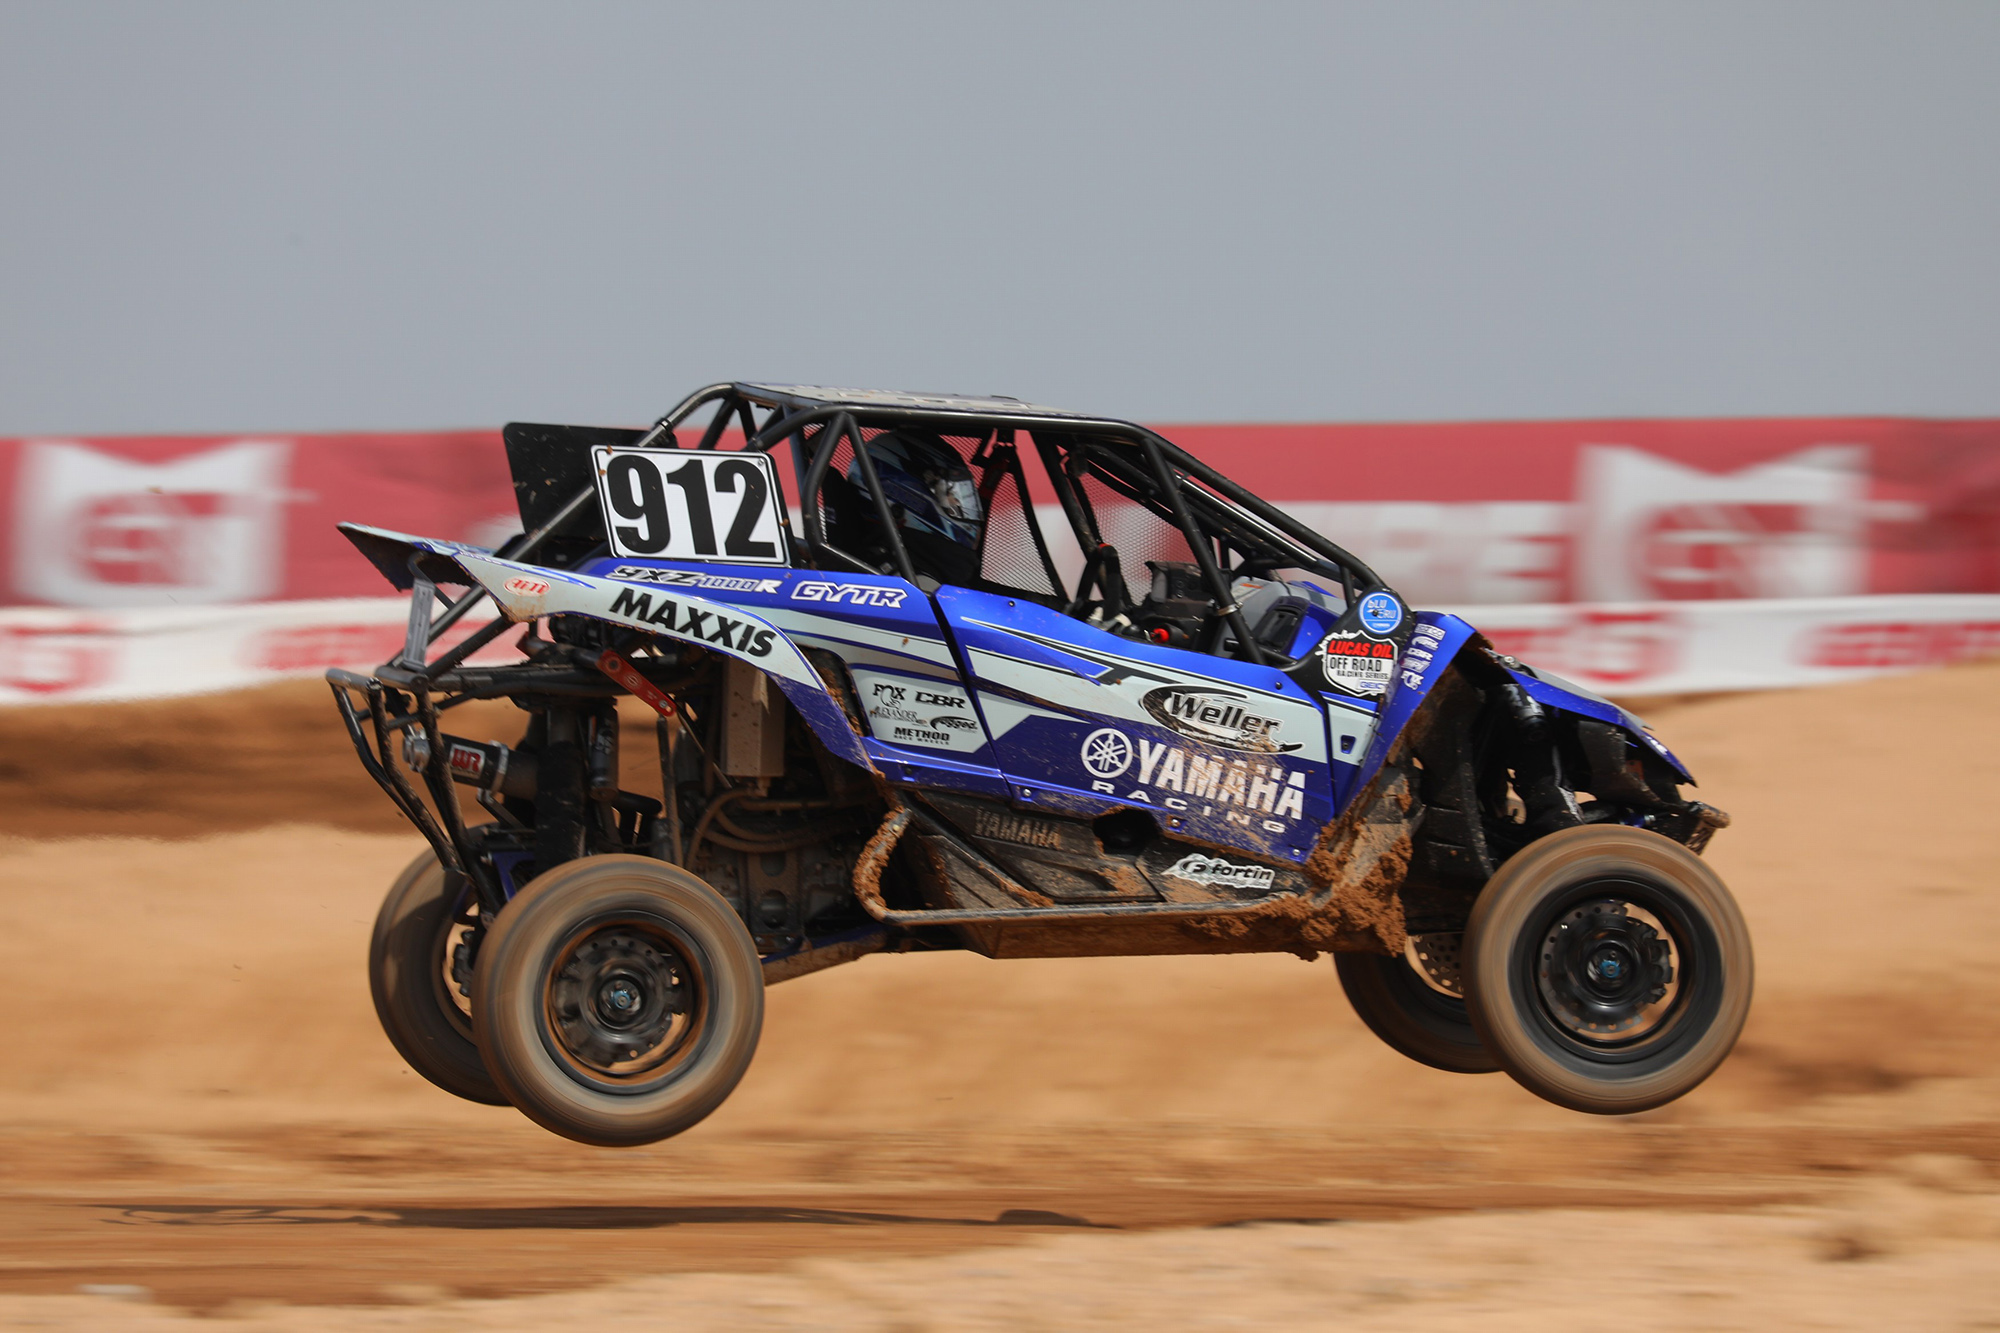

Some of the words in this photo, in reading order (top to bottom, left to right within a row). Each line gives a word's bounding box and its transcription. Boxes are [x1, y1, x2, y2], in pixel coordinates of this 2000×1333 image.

[606, 454, 777, 558] 912
[606, 564, 783, 595] YXZ1000R
[790, 579, 909, 609] GYTR
[608, 587, 778, 658] MAXXIS
[1327, 640, 1371, 657] LUCAS
[1371, 643, 1393, 659] OIL
[1329, 656, 1348, 670] OFF
[1352, 658, 1382, 673] ROAD
[872, 683, 906, 705] FOX
[915, 690, 966, 709] CBR
[1170, 692, 1281, 736] Weller
[894, 726, 950, 741] METHOD
[1137, 738, 1306, 821] YAMAHA
[1091, 779, 1287, 835] RACING
[974, 805, 1064, 851] YAMAHA
[1211, 863, 1273, 881] fortin
